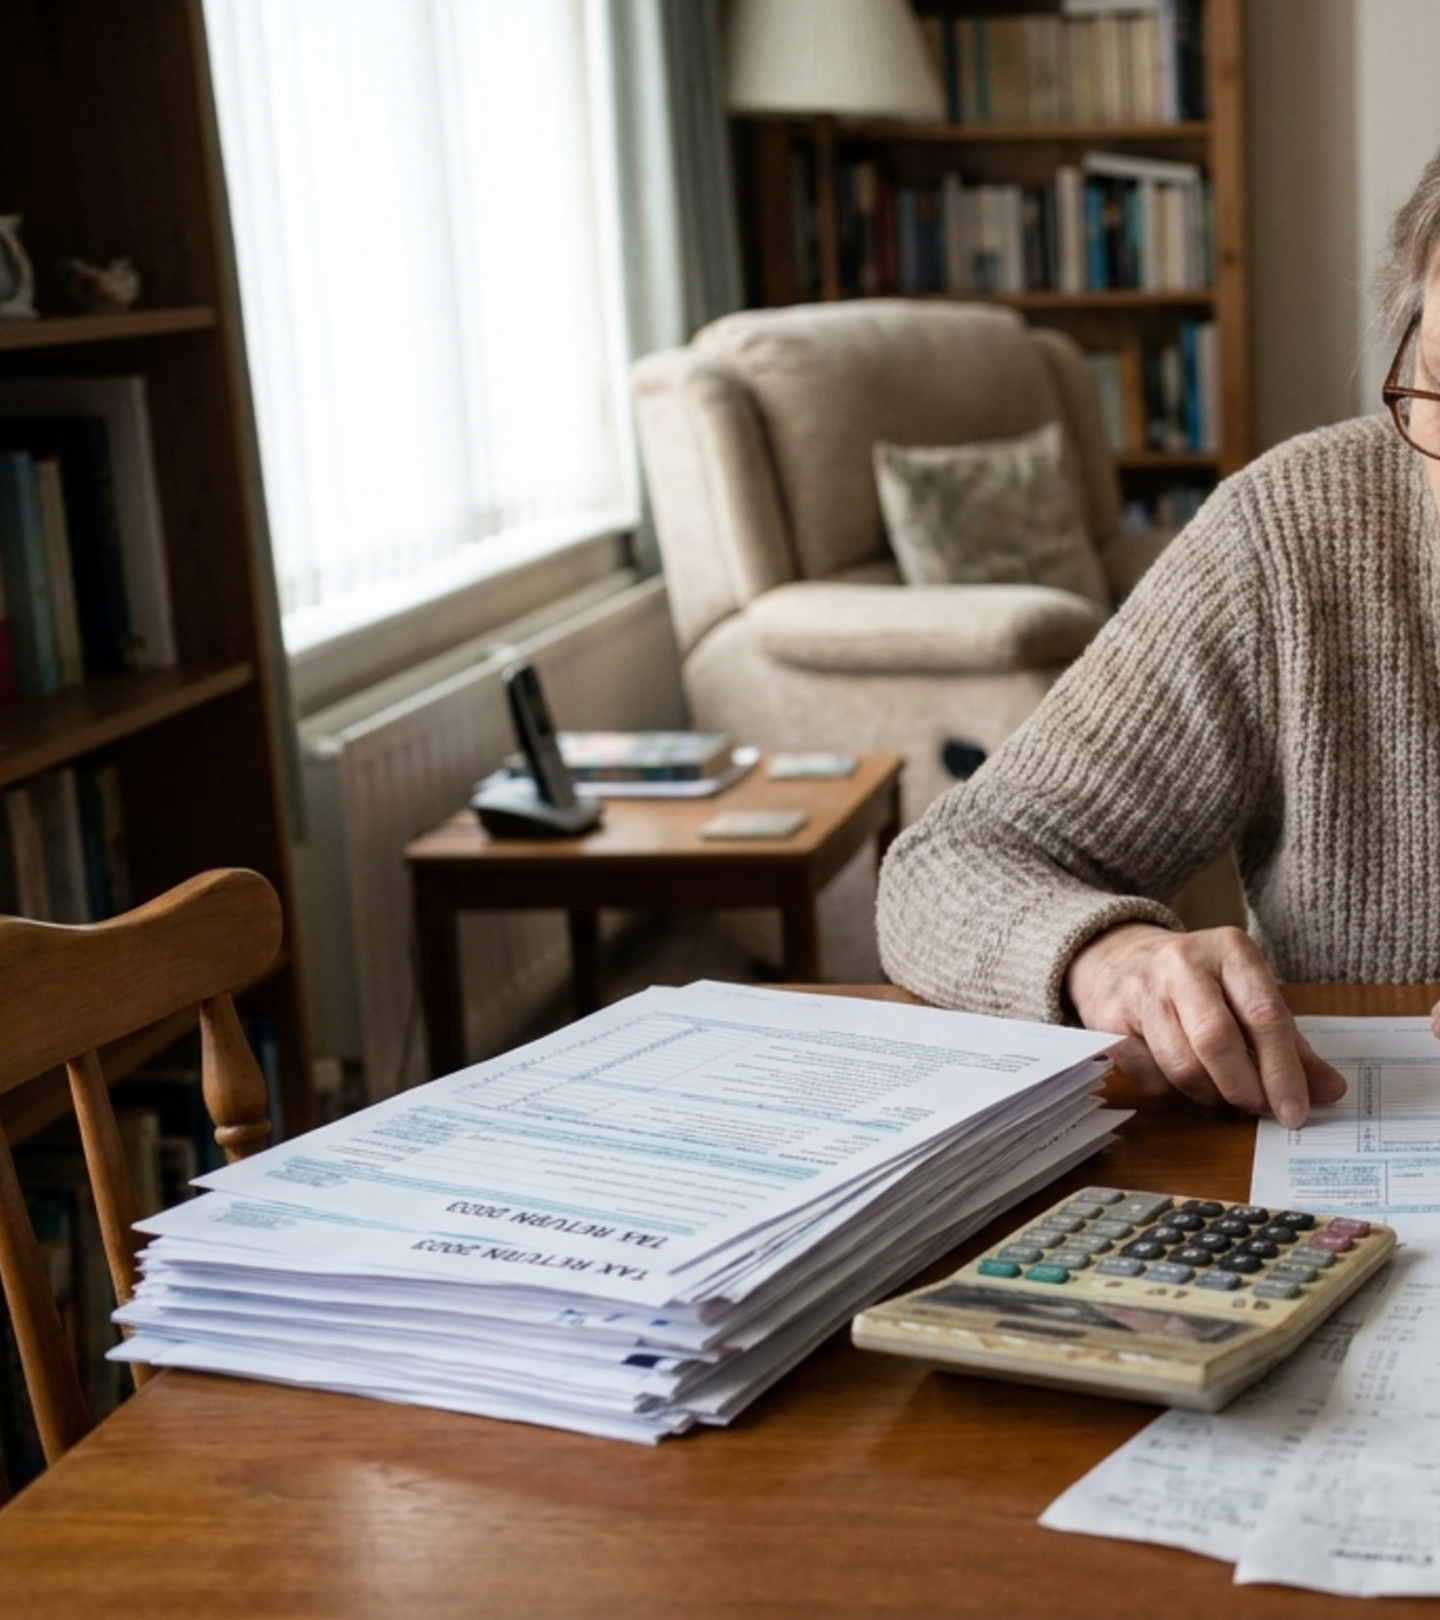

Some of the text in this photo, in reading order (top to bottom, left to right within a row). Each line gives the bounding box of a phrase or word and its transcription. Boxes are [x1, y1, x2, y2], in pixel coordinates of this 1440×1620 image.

[509, 1211, 616, 1238] RETURN
[617, 1231, 669, 1250] TAX
[481, 1247, 593, 1272] RETURN
[597, 1262, 650, 1281] TAX
